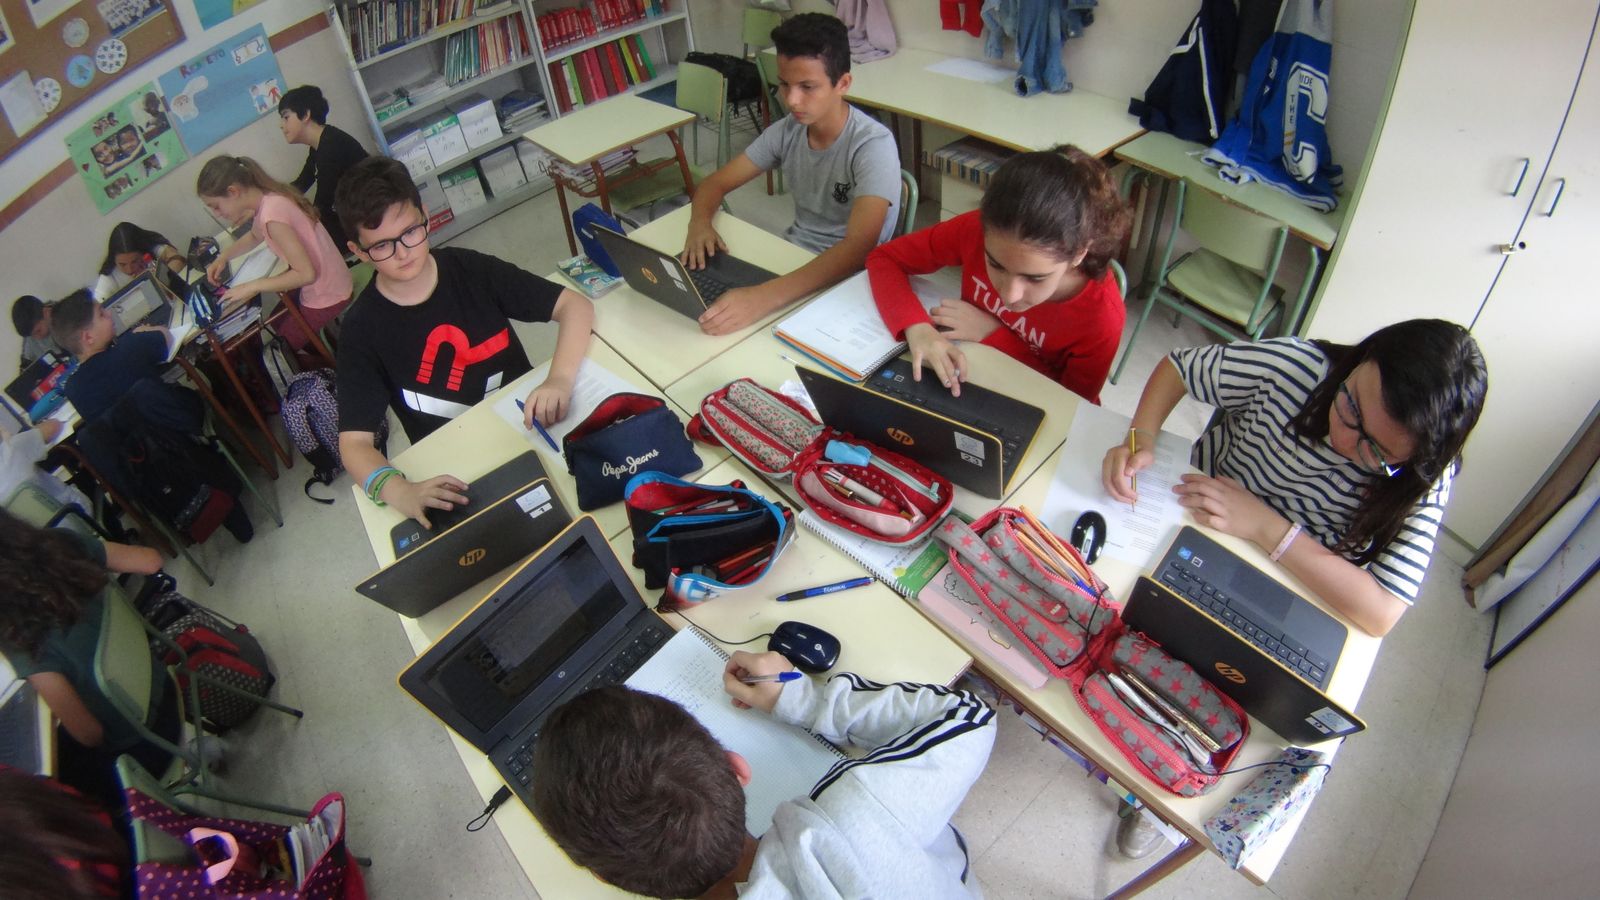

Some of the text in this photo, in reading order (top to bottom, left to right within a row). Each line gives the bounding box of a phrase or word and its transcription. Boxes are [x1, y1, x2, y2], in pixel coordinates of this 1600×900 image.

[971, 275, 1046, 348] TUCAN
[886, 427, 914, 446] hp
[602, 449, 660, 480] Pepe Jeans
[458, 548, 486, 567] hp
[1215, 661, 1246, 684] hp
